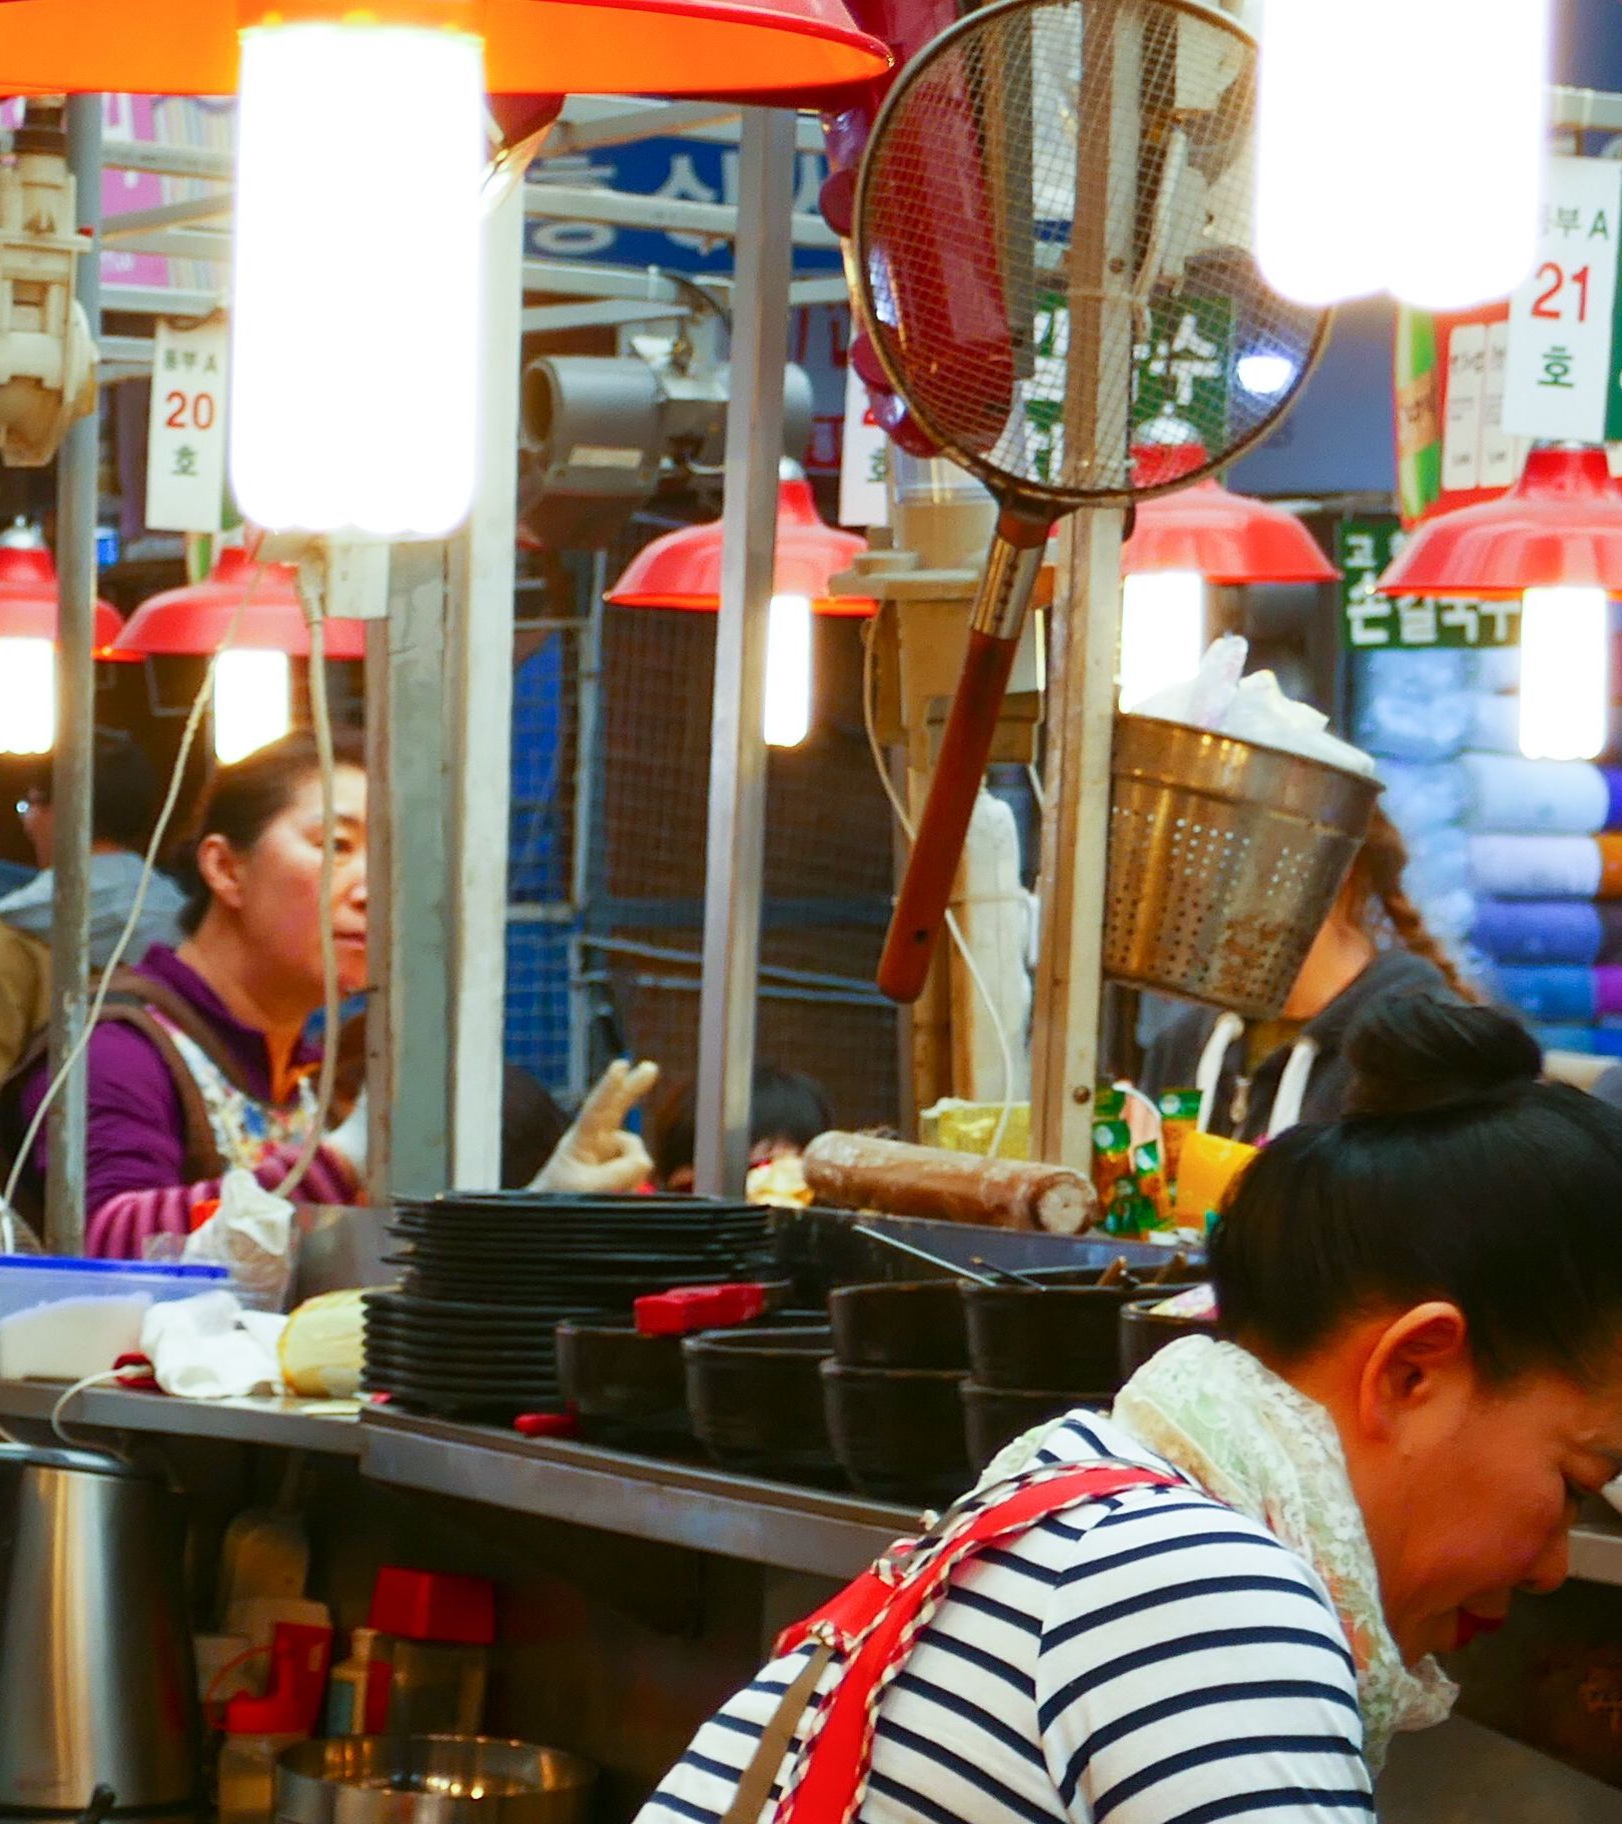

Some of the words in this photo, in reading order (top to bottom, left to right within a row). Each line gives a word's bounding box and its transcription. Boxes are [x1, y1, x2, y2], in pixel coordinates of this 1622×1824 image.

[1531, 262, 1592, 323] 21
[1536, 345, 1575, 389] 호
[165, 391, 214, 430] 20
[171, 445, 199, 476] 호
